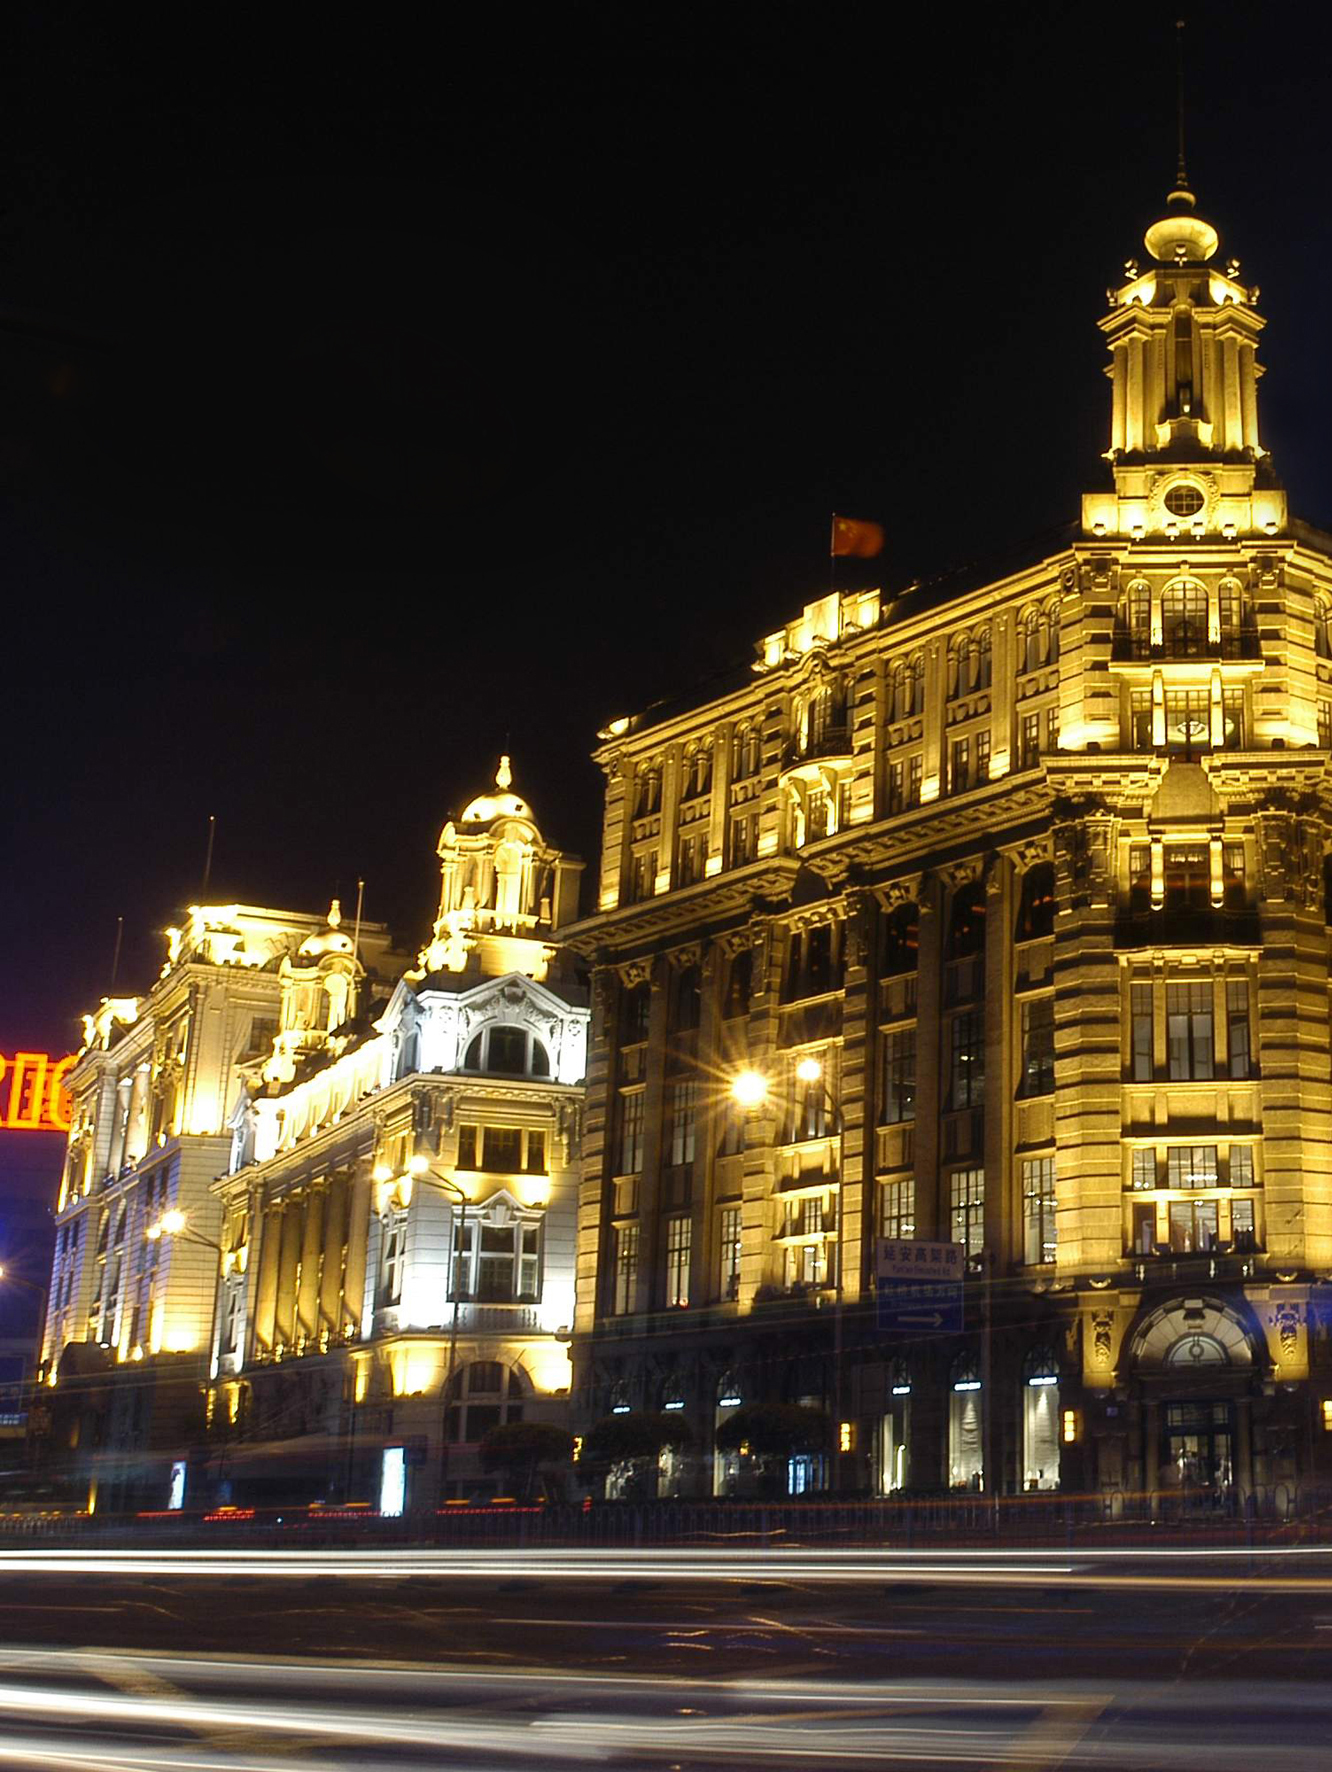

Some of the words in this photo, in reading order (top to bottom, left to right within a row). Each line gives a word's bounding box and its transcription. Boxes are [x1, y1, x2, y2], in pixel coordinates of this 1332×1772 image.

[884, 1245, 957, 1265] 延安高架路
